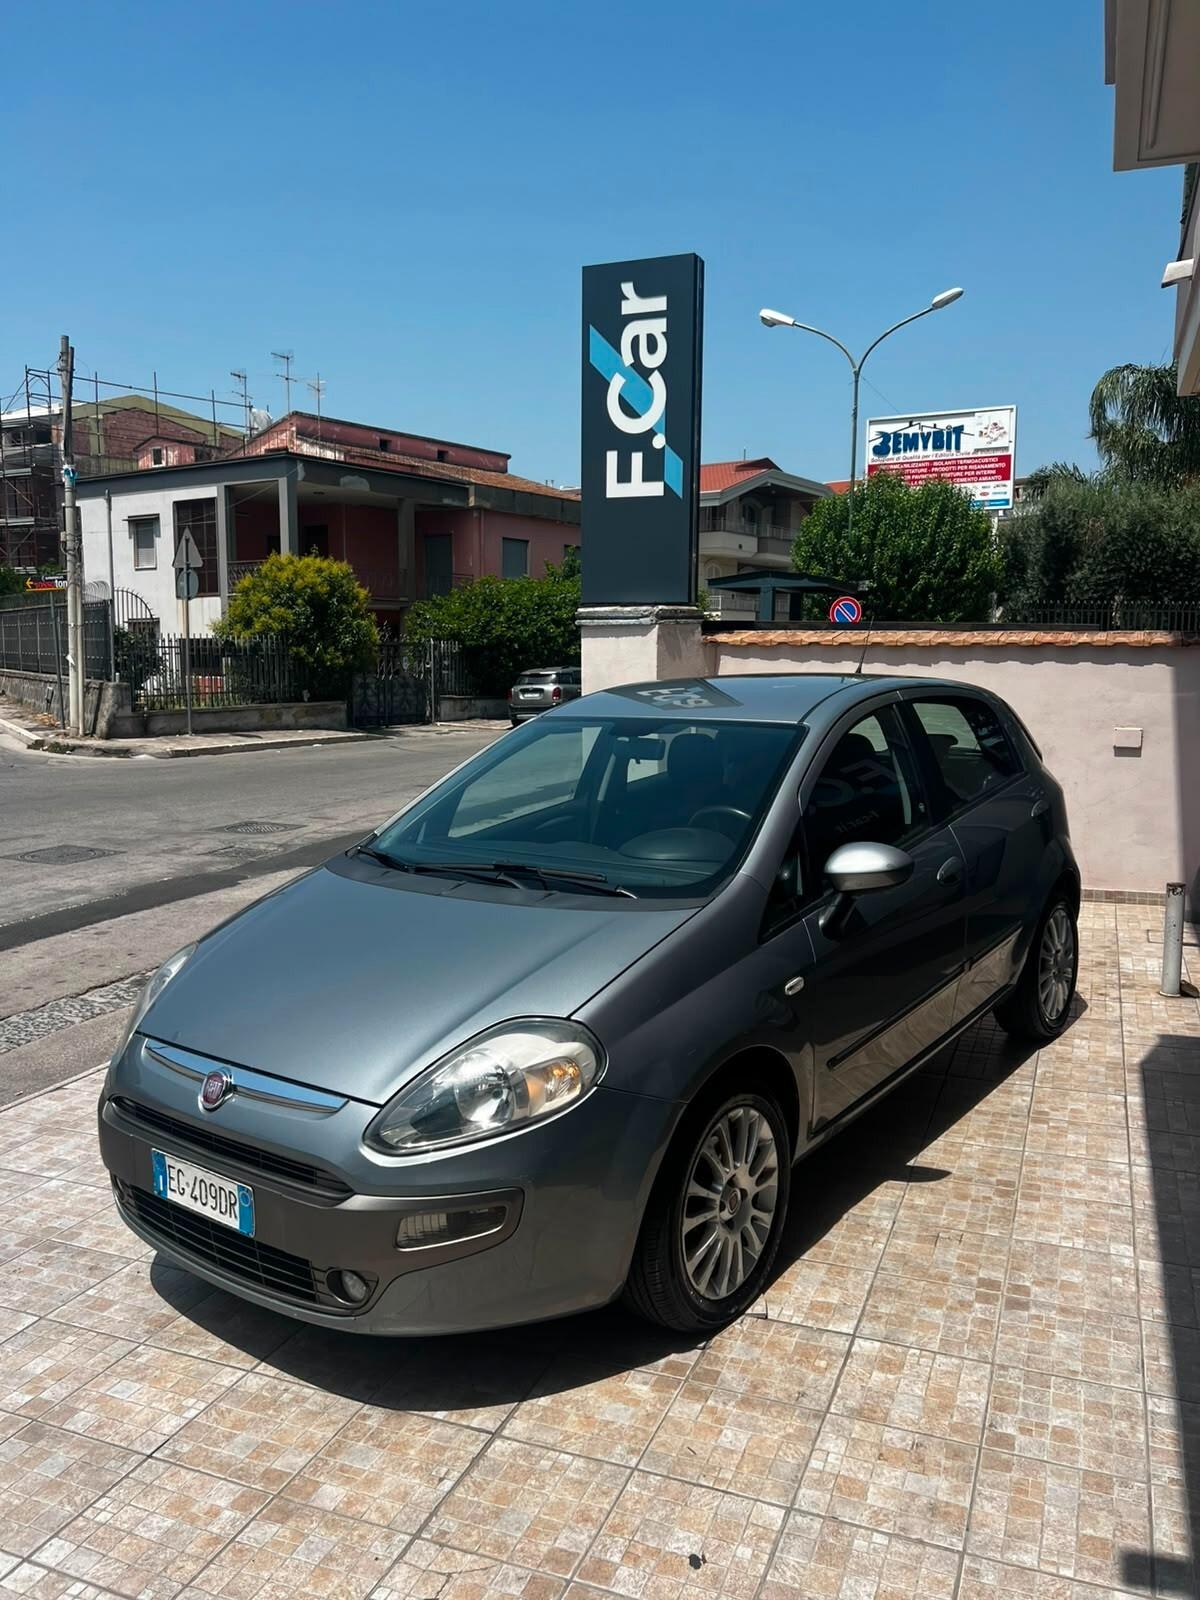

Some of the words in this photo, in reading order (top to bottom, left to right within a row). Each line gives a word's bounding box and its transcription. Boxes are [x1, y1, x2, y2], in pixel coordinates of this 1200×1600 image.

[606, 281, 668, 498] F.Car
[957, 457, 998, 465] TERMOACUSTICI
[969, 462, 1006, 470] RISANAMENTO
[979, 474, 1002, 482] AMIANTO
